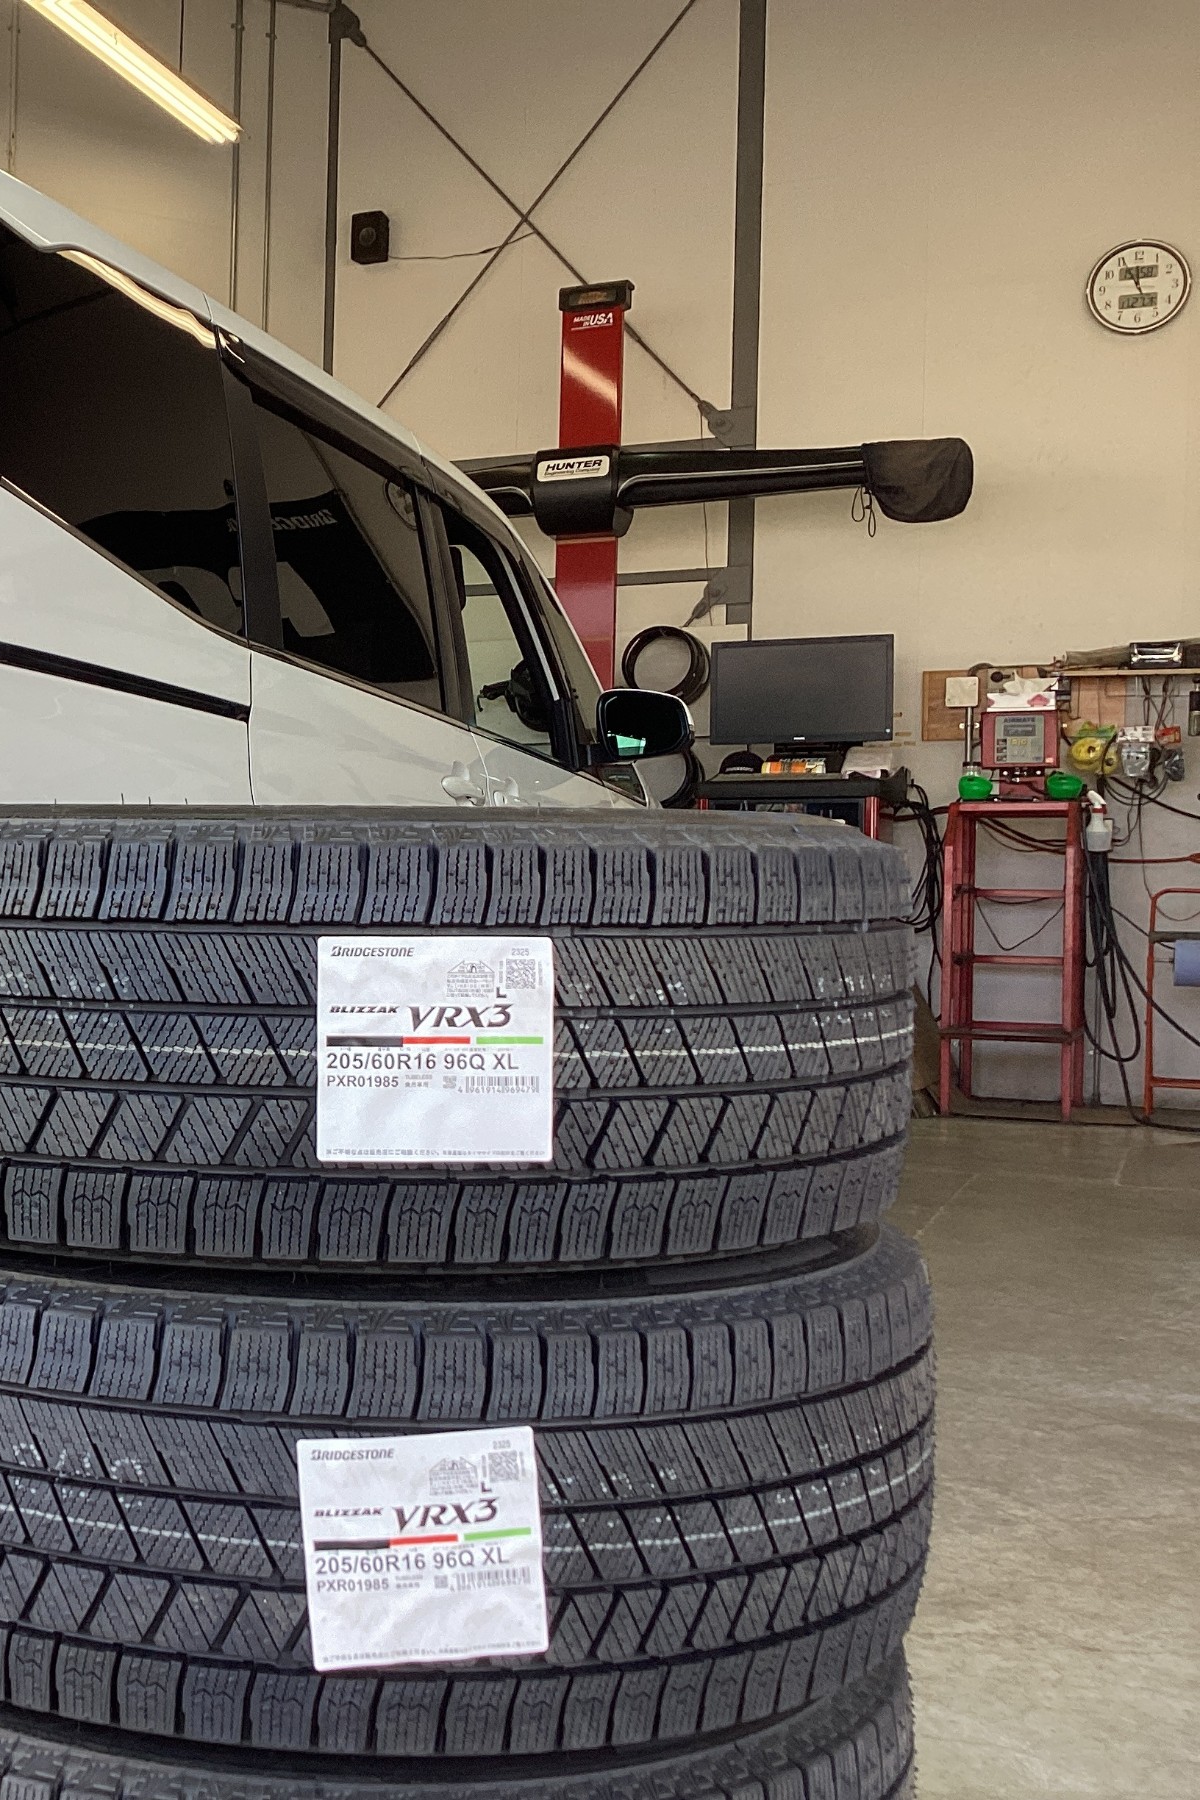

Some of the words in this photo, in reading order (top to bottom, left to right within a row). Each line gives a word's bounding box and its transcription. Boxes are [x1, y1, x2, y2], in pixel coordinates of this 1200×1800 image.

[1134, 250, 1144, 260] 12
[1165, 263, 1173, 274] 2
[1105, 270, 1114, 280] 10
[1172, 279, 1179, 289] 3
[1098, 286, 1106, 296] 9
[1104, 300, 1112, 310] 8
[590, 312, 613, 326] USA
[1117, 311, 1124, 321] 7
[1134, 313, 1141, 323] 6
[545, 459, 603, 471] HUNTER
[330, 946, 415, 958] BRIDGESTONE
[511, 948, 530, 957] 2325
[496, 987, 507, 998] L
[329, 1005, 399, 1014] BLIZZAK
[406, 1003, 515, 1032] VRX3
[326, 1053, 437, 1070] 205/60R16
[443, 1053, 486, 1071] 96Q
[493, 1053, 519, 1070] XL
[326, 1075, 399, 1088] PXR01985
[311, 1448, 395, 1461] BRIDGESTONE
[481, 1481, 492, 1493] L
[314, 1507, 384, 1518] BLIZZAK
[391, 1497, 500, 1533] VRX3
[315, 1553, 426, 1575] 205/60R16
[433, 1550, 475, 1569] 96Q
[482, 1547, 510, 1566] XL
[317, 1577, 390, 1593] PXR01985
